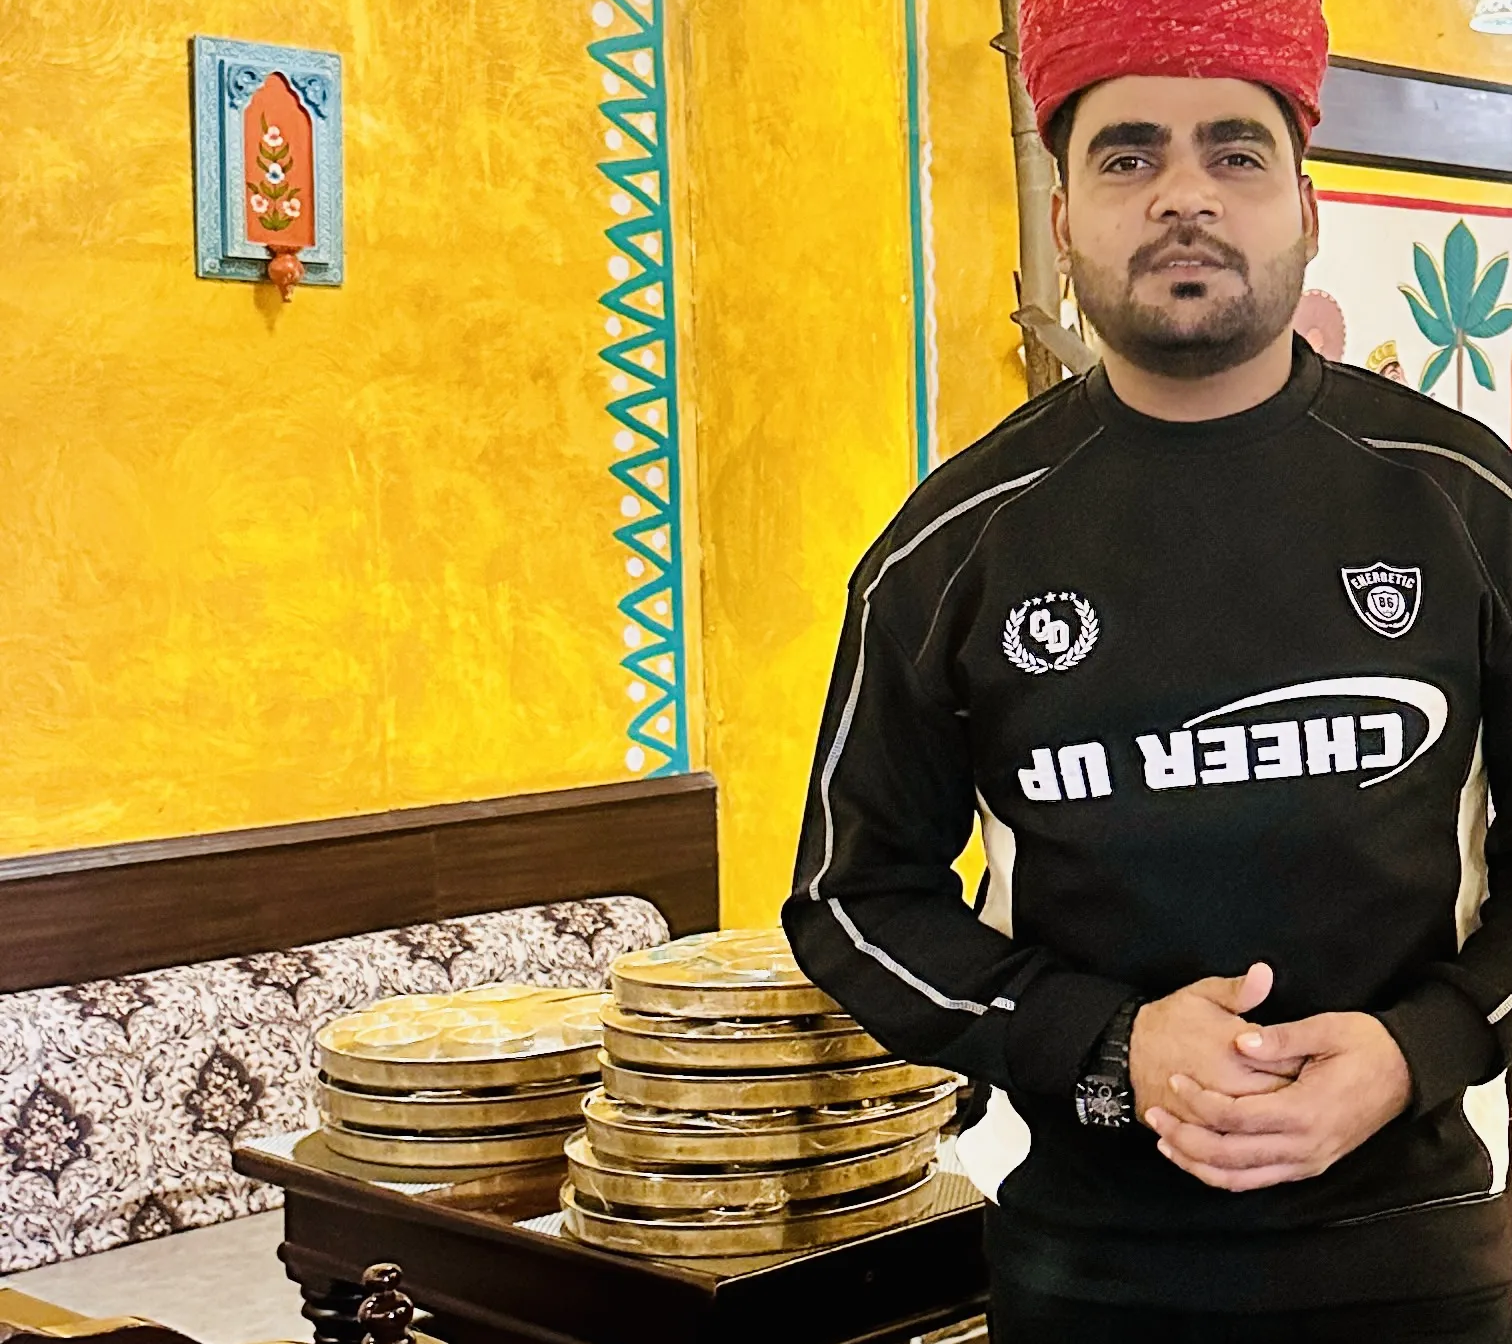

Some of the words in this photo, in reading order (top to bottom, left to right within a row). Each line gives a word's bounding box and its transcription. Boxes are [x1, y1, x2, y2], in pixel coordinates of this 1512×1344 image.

[1350, 571, 1416, 590] ENERGETIC
[1018, 742, 1112, 801] UP
[1136, 713, 1404, 789] CHEER
